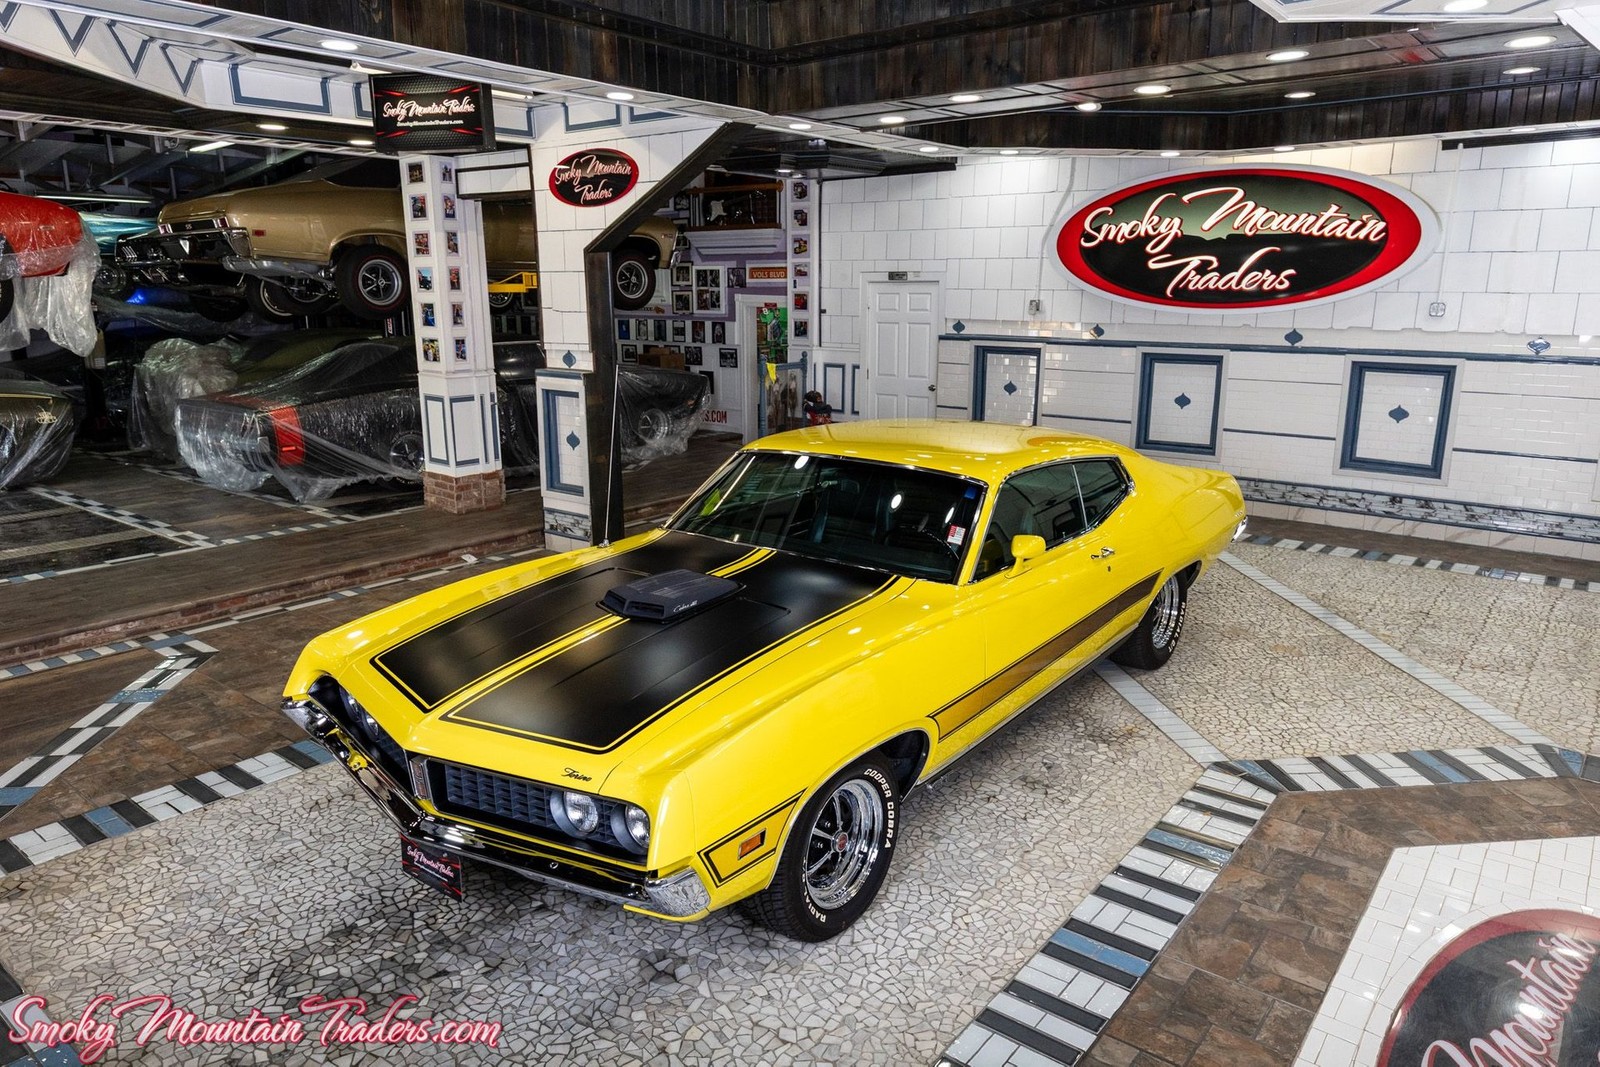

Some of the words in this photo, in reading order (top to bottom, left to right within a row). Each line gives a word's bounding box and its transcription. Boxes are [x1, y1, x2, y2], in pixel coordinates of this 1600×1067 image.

[382, 99, 407, 121] Smoky
[404, 100, 447, 117] Mountain
[443, 96, 475, 115] Traders
[554, 159, 582, 185] Smoky
[580, 154, 632, 176] Mountain
[574, 179, 613, 204] Traders
[1080, 193, 1183, 256] Smoky
[1182, 186, 1386, 243] Mountain
[752, 270, 769, 279] VOLS
[770, 270, 786, 279] BLVD
[1146, 246, 1297, 298] Traders
[560, 767, 592, 782] Torino
[864, 768, 892, 797] COOPER
[884, 802, 894, 848] COBRA
